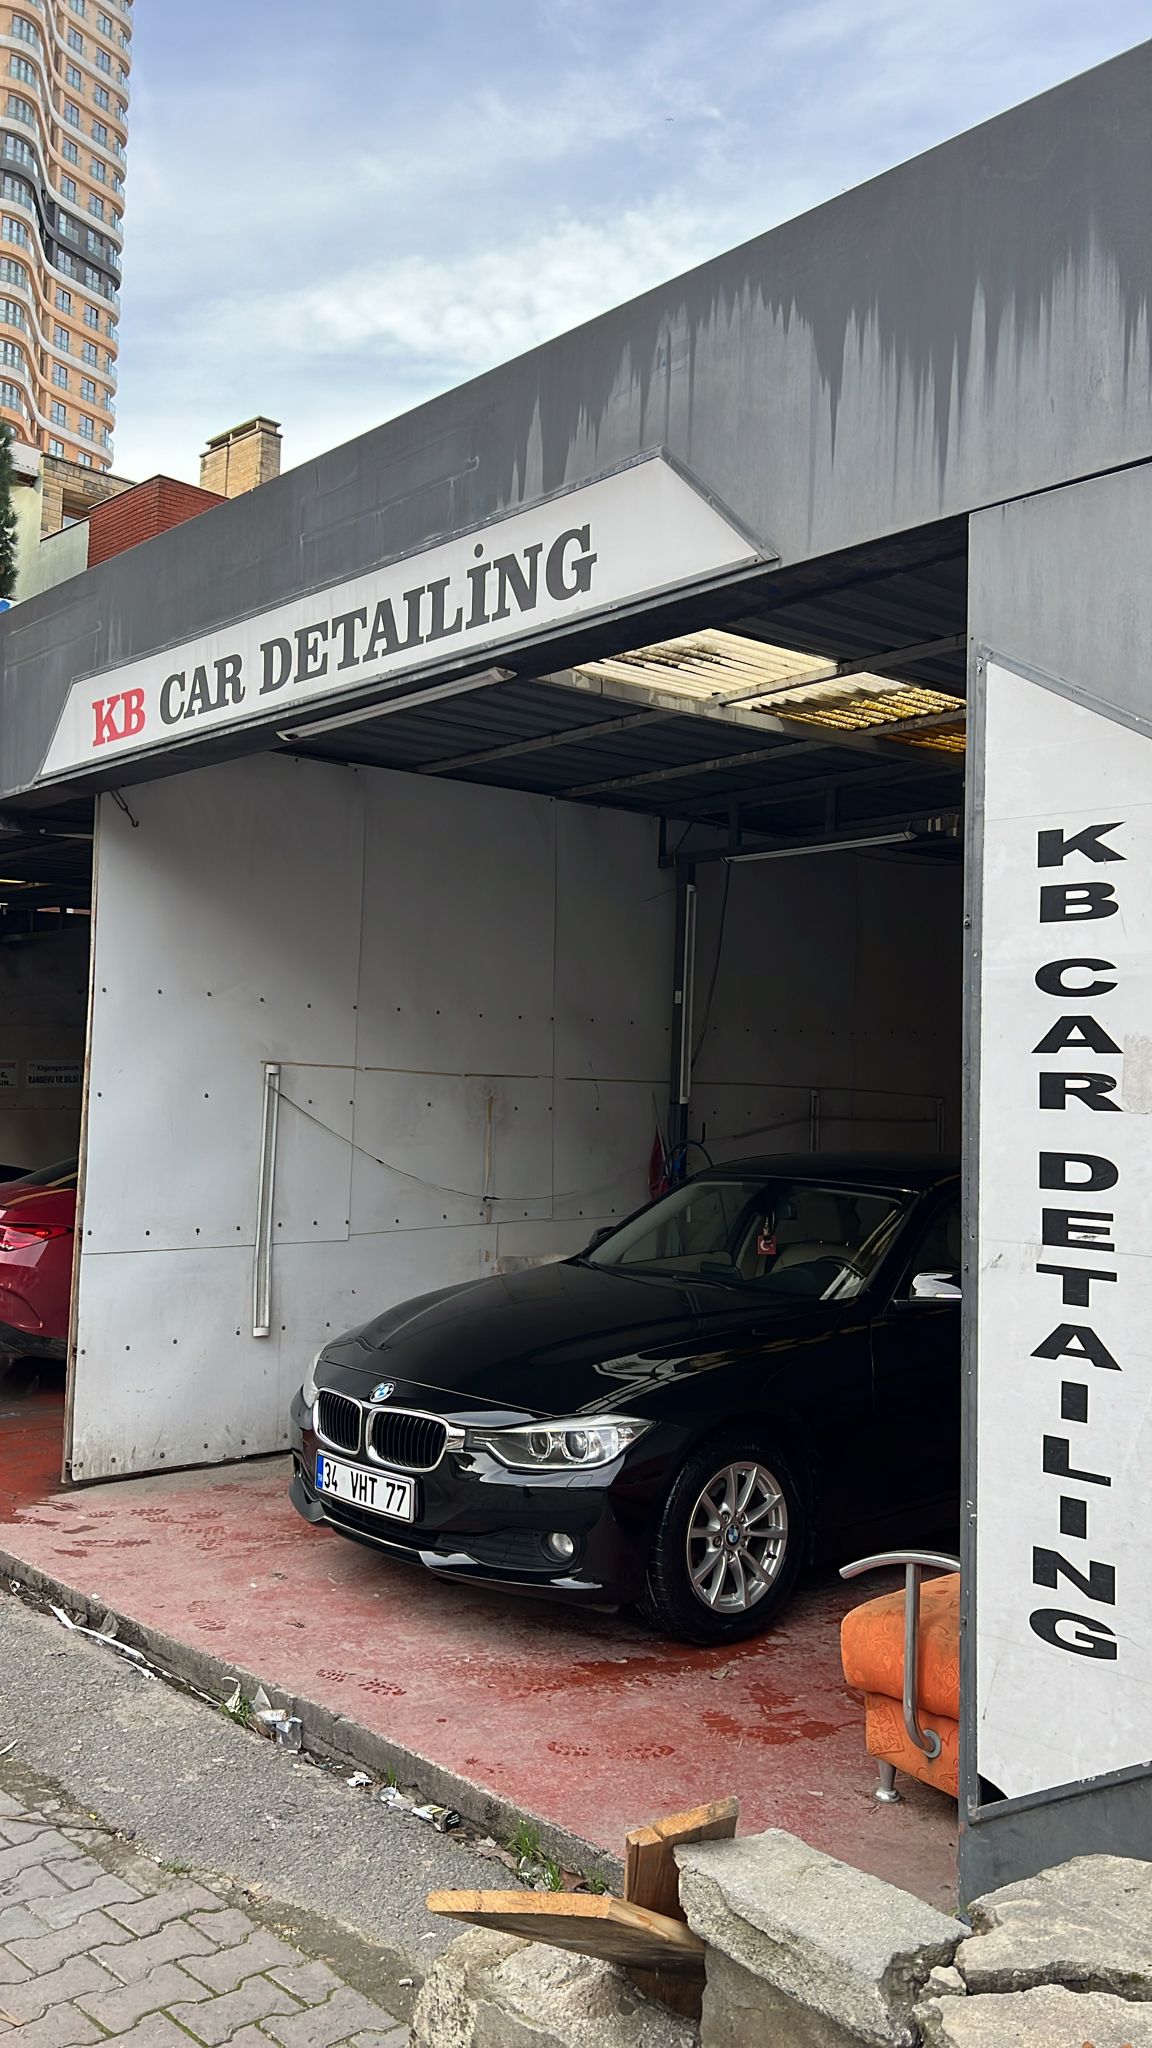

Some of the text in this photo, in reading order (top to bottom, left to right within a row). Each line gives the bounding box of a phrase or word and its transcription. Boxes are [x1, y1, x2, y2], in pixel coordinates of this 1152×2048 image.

[91, 523, 599, 748] KB CAR DETAILİNG
[1029, 821, 1128, 1661] KB CAR DETAILING
[324, 1461, 407, 1512] 34 VHT 77
